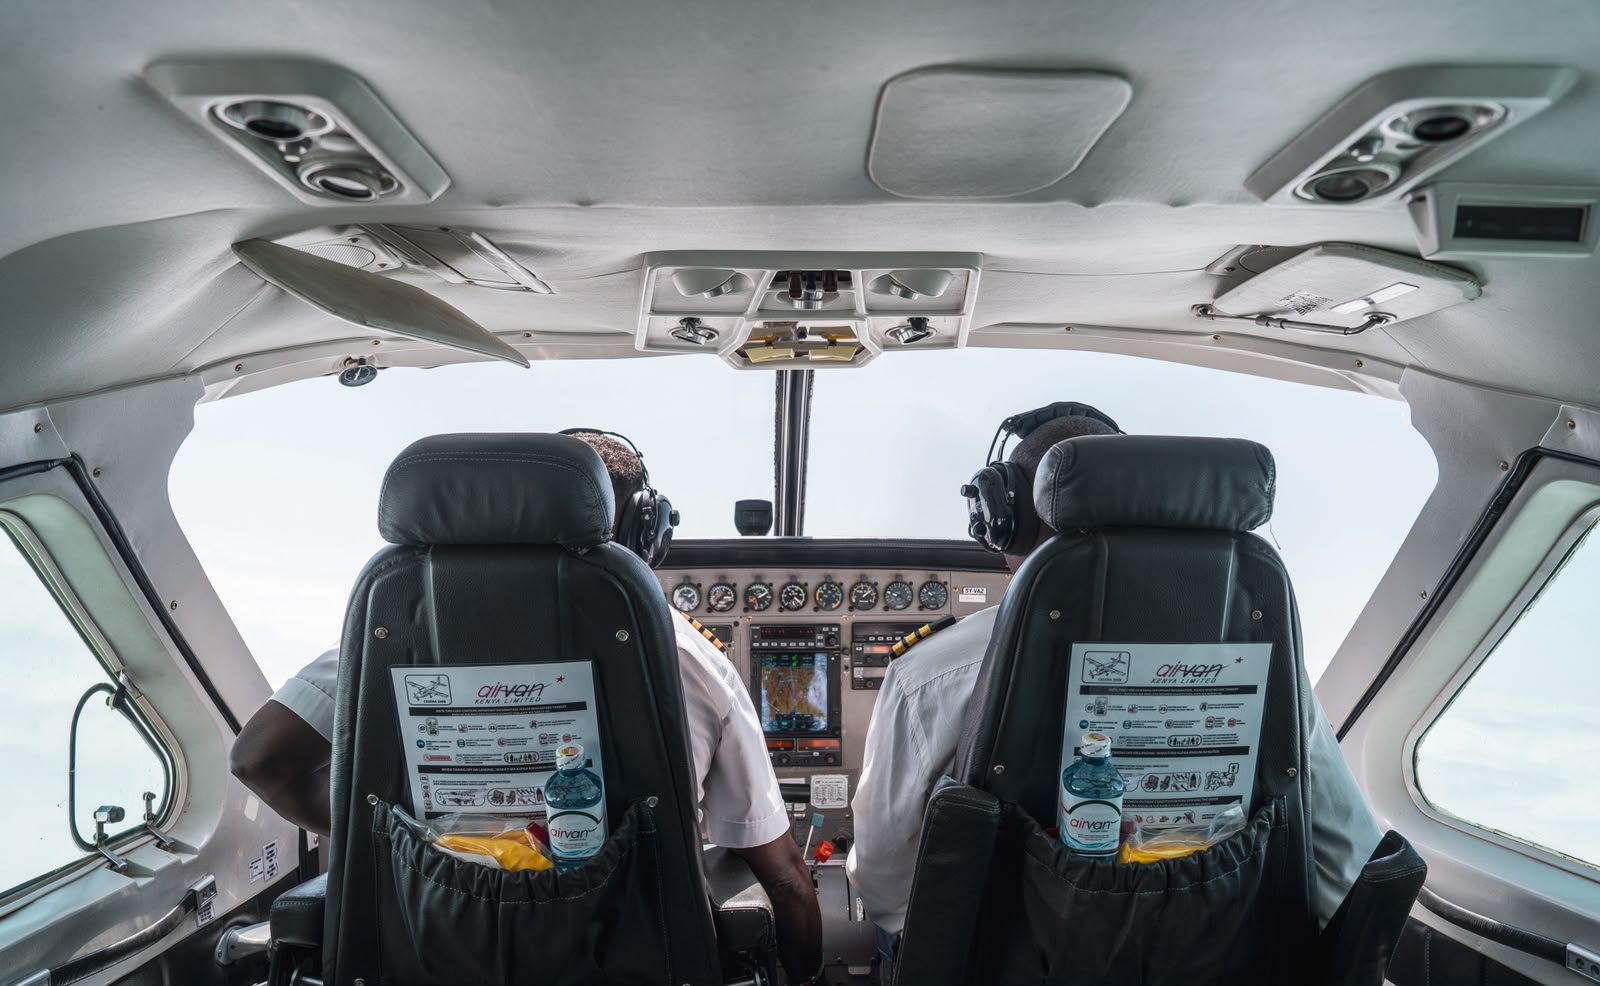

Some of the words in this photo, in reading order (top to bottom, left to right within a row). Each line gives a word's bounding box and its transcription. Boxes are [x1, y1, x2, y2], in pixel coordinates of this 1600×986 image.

[1156, 661, 1223, 678] airvan
[477, 682, 545, 698] airvan
[1070, 818, 1110, 830] airvan
[550, 828, 589, 839] airvan
